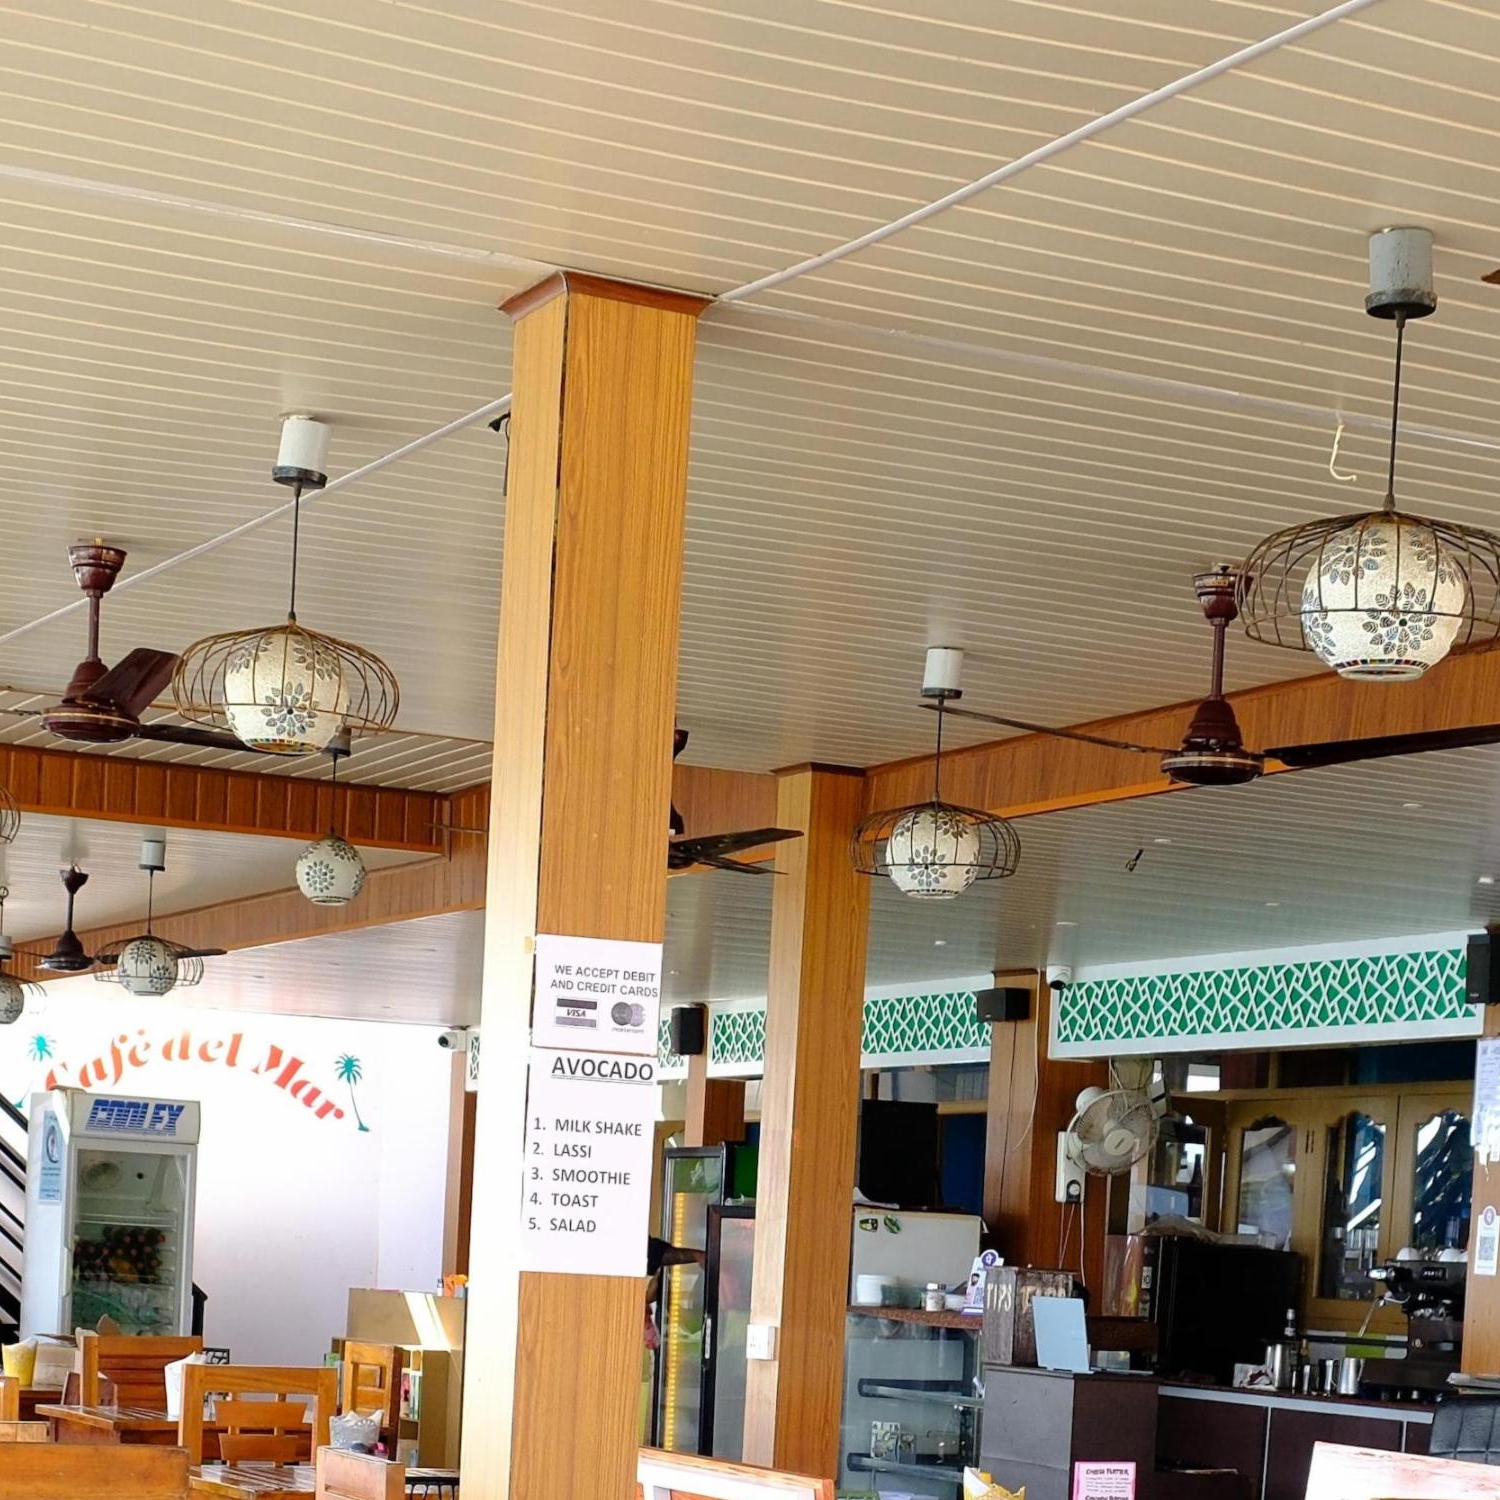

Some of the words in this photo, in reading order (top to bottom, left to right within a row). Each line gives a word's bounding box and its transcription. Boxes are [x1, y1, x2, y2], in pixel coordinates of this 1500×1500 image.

[554, 964, 573, 976] WE
[575, 966, 620, 980] ACCEPT
[623, 970, 656, 983] DEBIT
[550, 979, 574, 990] AND
[576, 981, 617, 994] CREDIT
[619, 985, 658, 998] CARDS
[566, 1008, 587, 1017] VISA
[161, 1029, 244, 1068] del
[251, 1044, 345, 1120] Mar
[551, 1056, 653, 1081] AVOCADO
[533, 1117, 546, 1131] 1.
[555, 1118, 591, 1133] MILK
[595, 1120, 642, 1137] SHAKE
[532, 1142, 544, 1156] 2.
[553, 1143, 592, 1158] LASSI
[531, 1167, 544, 1180] 3.
[552, 1168, 631, 1186] SMOOTHIE
[529, 1192, 543, 1206] 4.
[551, 1192, 599, 1208] TOAST
[528, 1217, 541, 1231] 5.
[550, 1217, 597, 1233] SALAD
[986, 1282, 1013, 1312] TIPS
